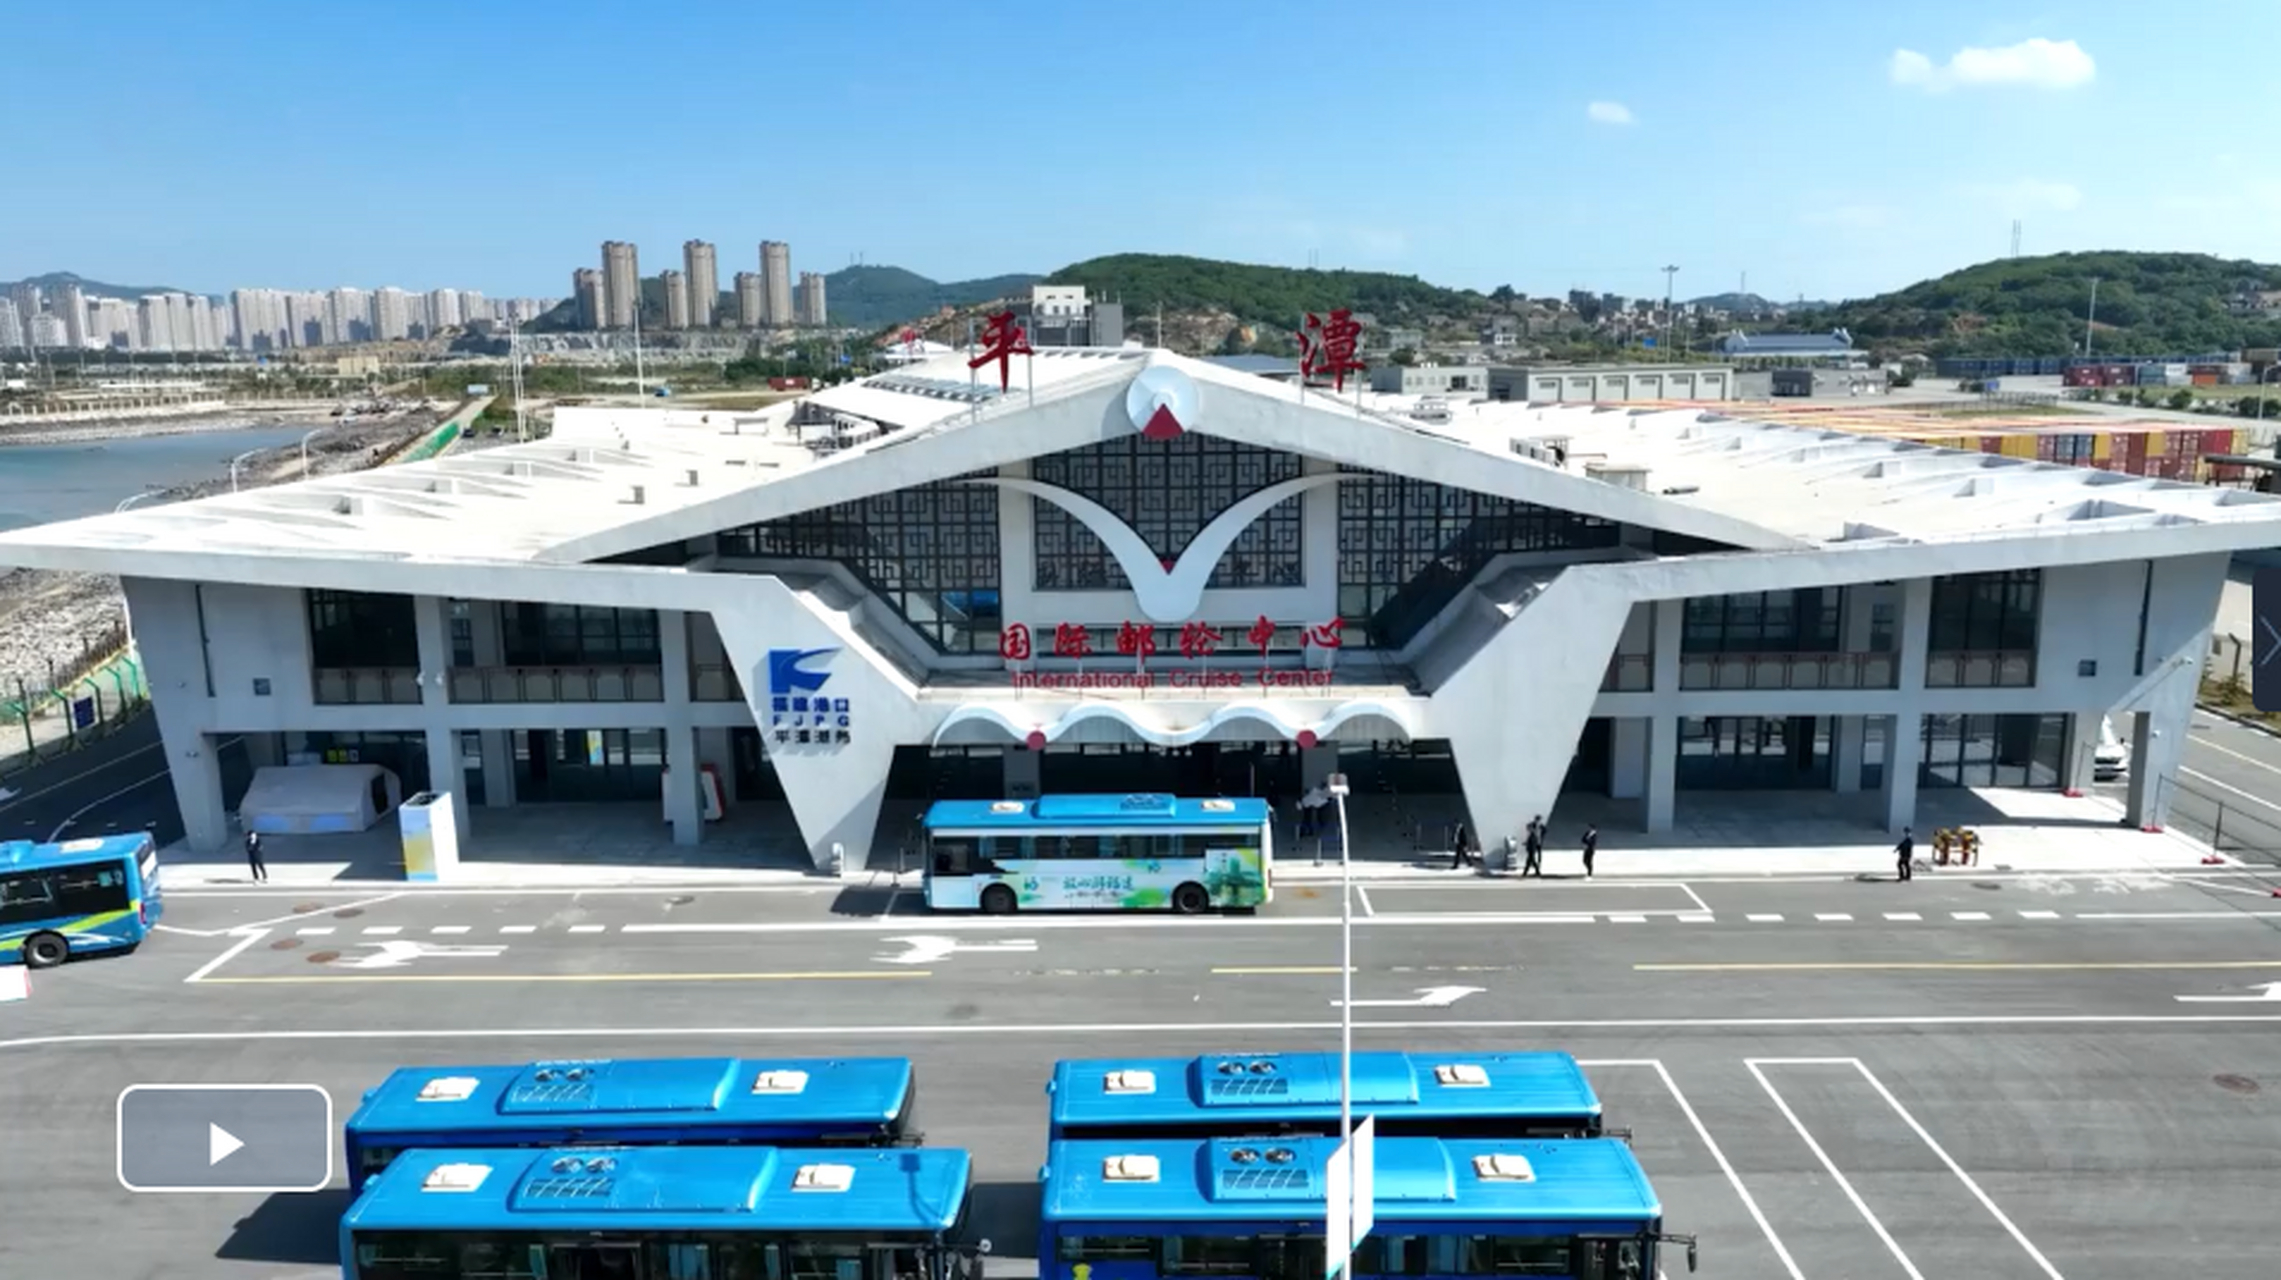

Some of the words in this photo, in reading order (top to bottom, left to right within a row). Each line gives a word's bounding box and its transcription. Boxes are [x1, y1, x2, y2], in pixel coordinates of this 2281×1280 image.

[999, 615, 1347, 663] 国际邮轮中心
[1012, 669, 1155, 688] International
[1169, 669, 1242, 688] Cruise
[1257, 667, 1334, 687] Center
